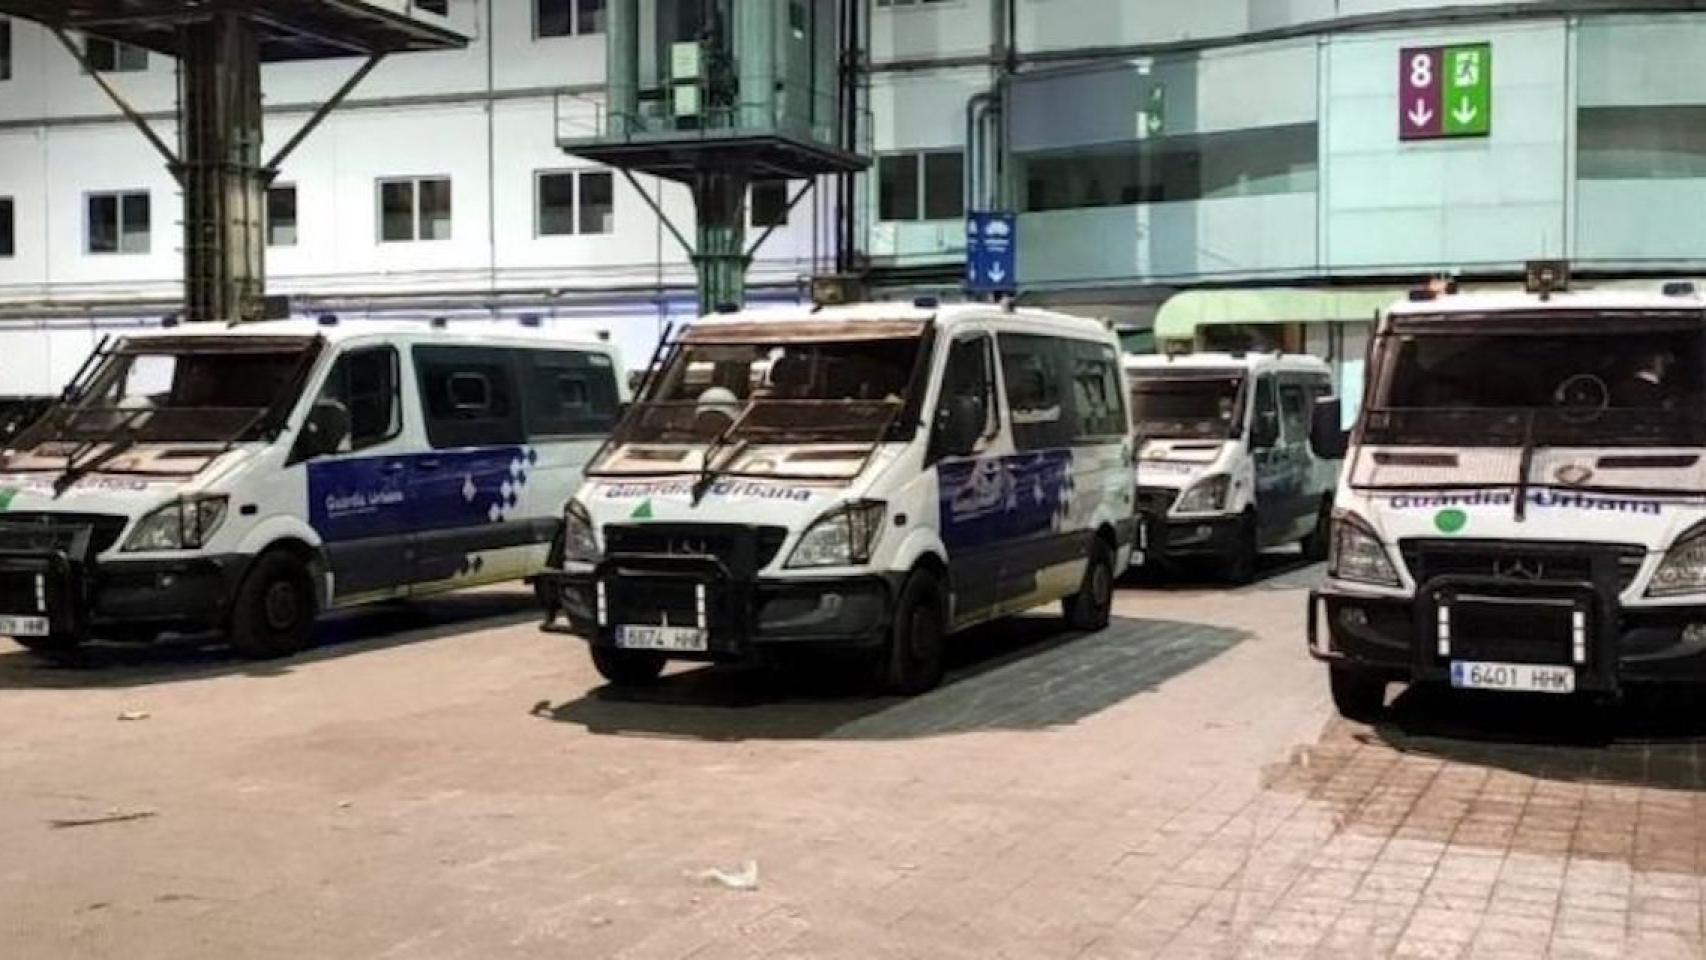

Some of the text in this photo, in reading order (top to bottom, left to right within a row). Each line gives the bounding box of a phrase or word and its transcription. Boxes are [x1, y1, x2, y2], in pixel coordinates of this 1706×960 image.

[1410, 53, 1432, 88] 8
[1390, 490, 1661, 515] Guardia Urbana
[1471, 664, 1569, 691] 6401 HHK
